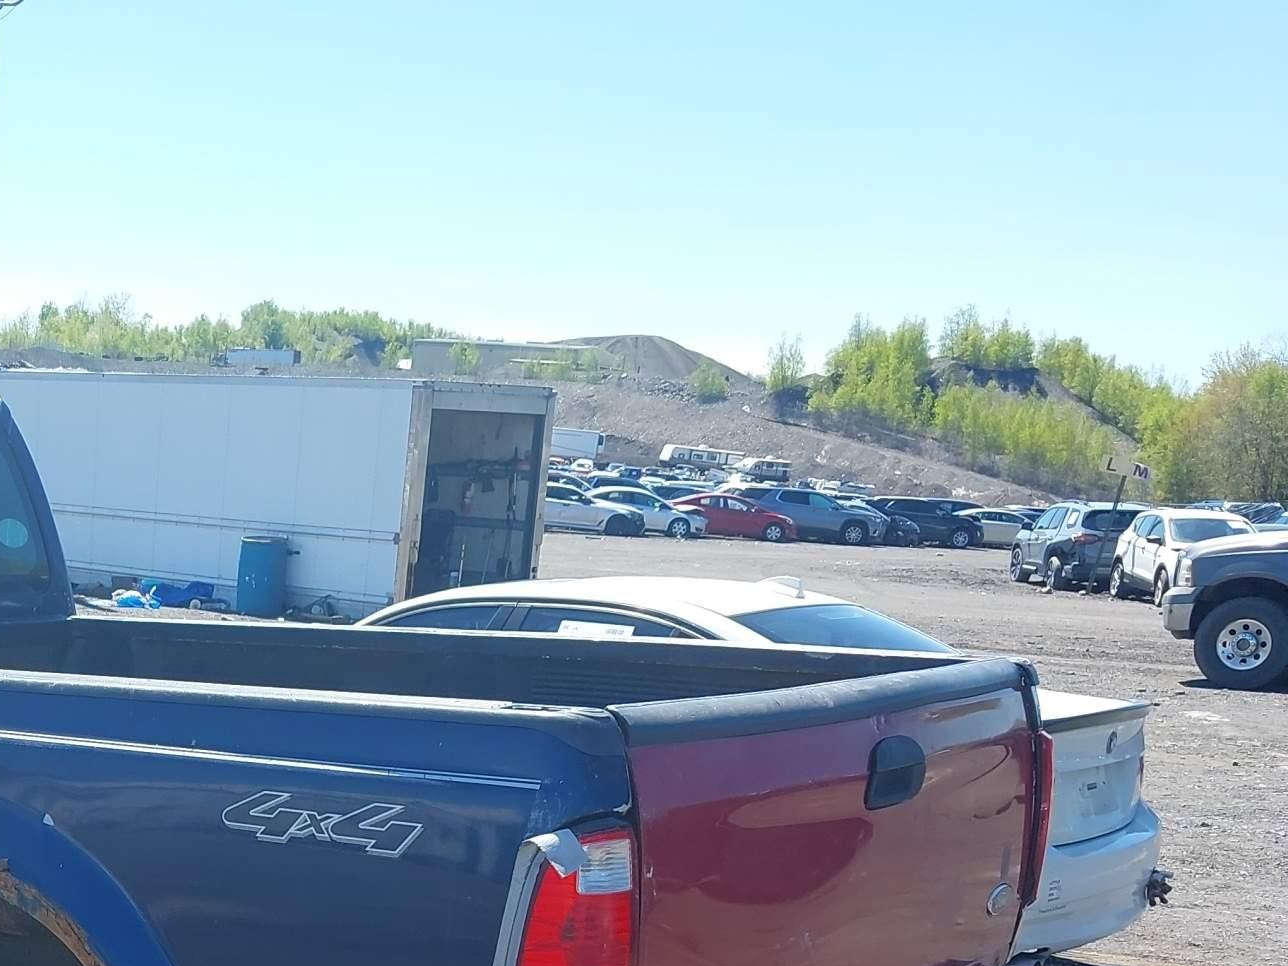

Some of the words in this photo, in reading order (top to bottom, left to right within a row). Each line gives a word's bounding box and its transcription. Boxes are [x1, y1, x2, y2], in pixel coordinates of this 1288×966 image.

[1107, 457, 1116, 472] L
[1133, 464, 1149, 479] M
[222, 790, 425, 859] 4x4
